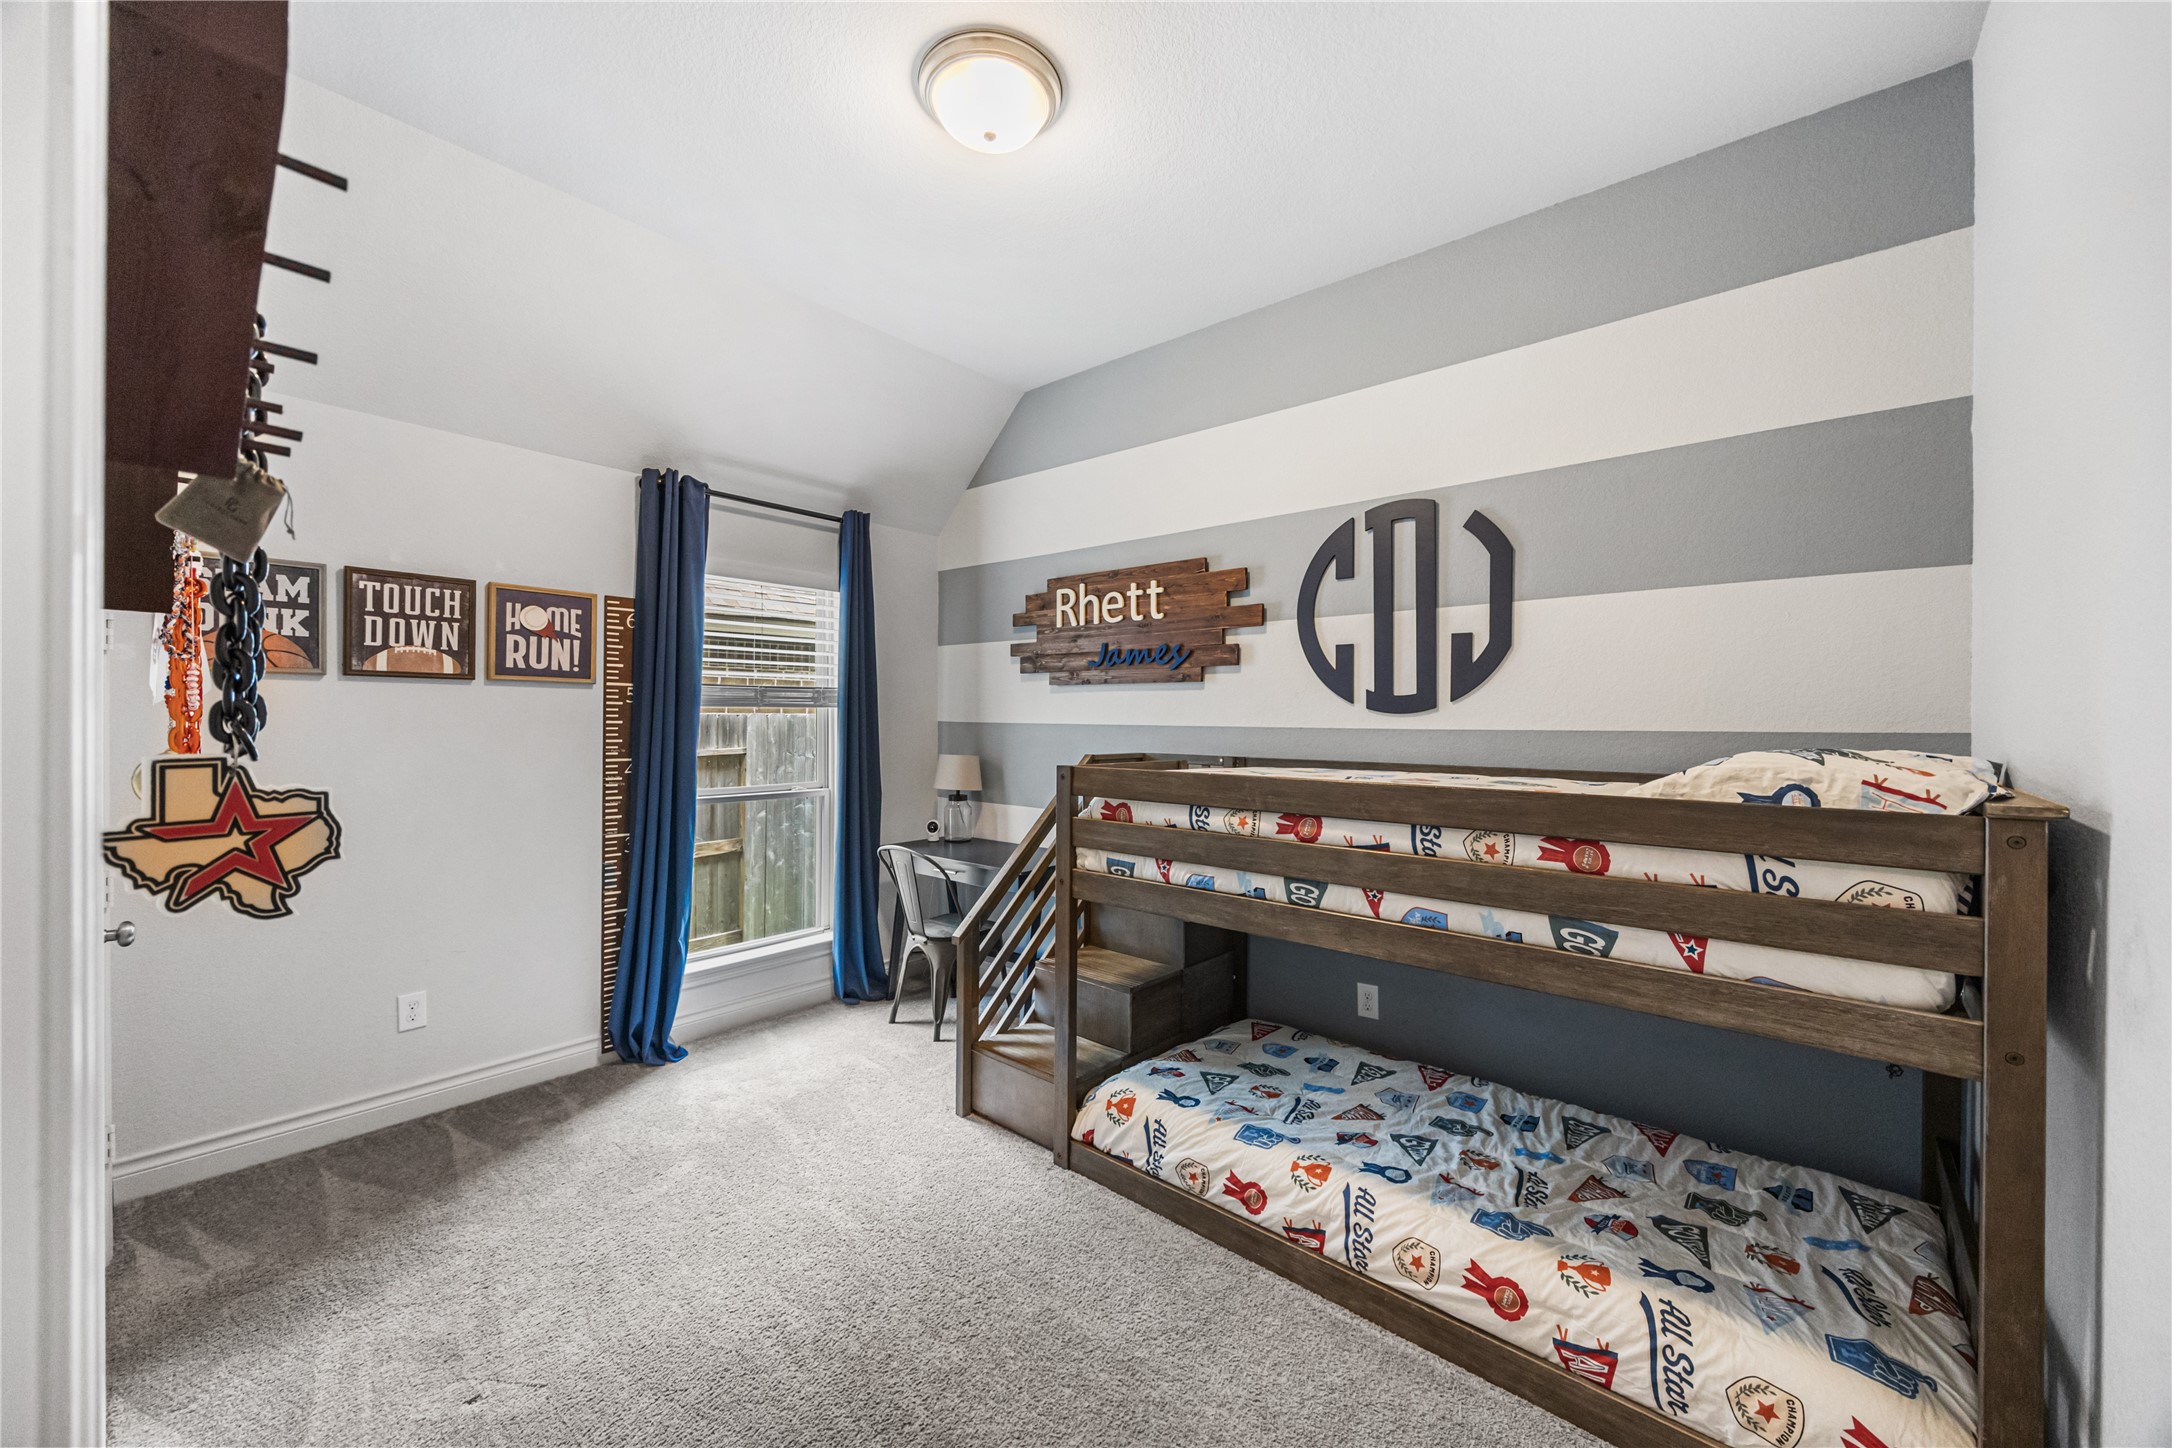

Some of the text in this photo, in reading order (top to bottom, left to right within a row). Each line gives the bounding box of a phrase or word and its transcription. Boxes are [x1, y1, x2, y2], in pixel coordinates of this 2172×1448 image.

[358, 580, 462, 618] TOUCH
[1055, 580, 1166, 628] Rhett
[363, 615, 460, 651] DOWN
[505, 633, 581, 672] RUN!
[1087, 641, 1193, 670] James
[1419, 825, 1443, 858] Sta
[1289, 882, 1320, 906] GO
[1152, 1118, 1168, 1149] All
[1352, 1187, 1377, 1273] All Star
[1423, 1250, 1437, 1287] CHAMPION
[1658, 1297, 1696, 1417] All Star
[1774, 1398, 1798, 1447] CHAMPION
